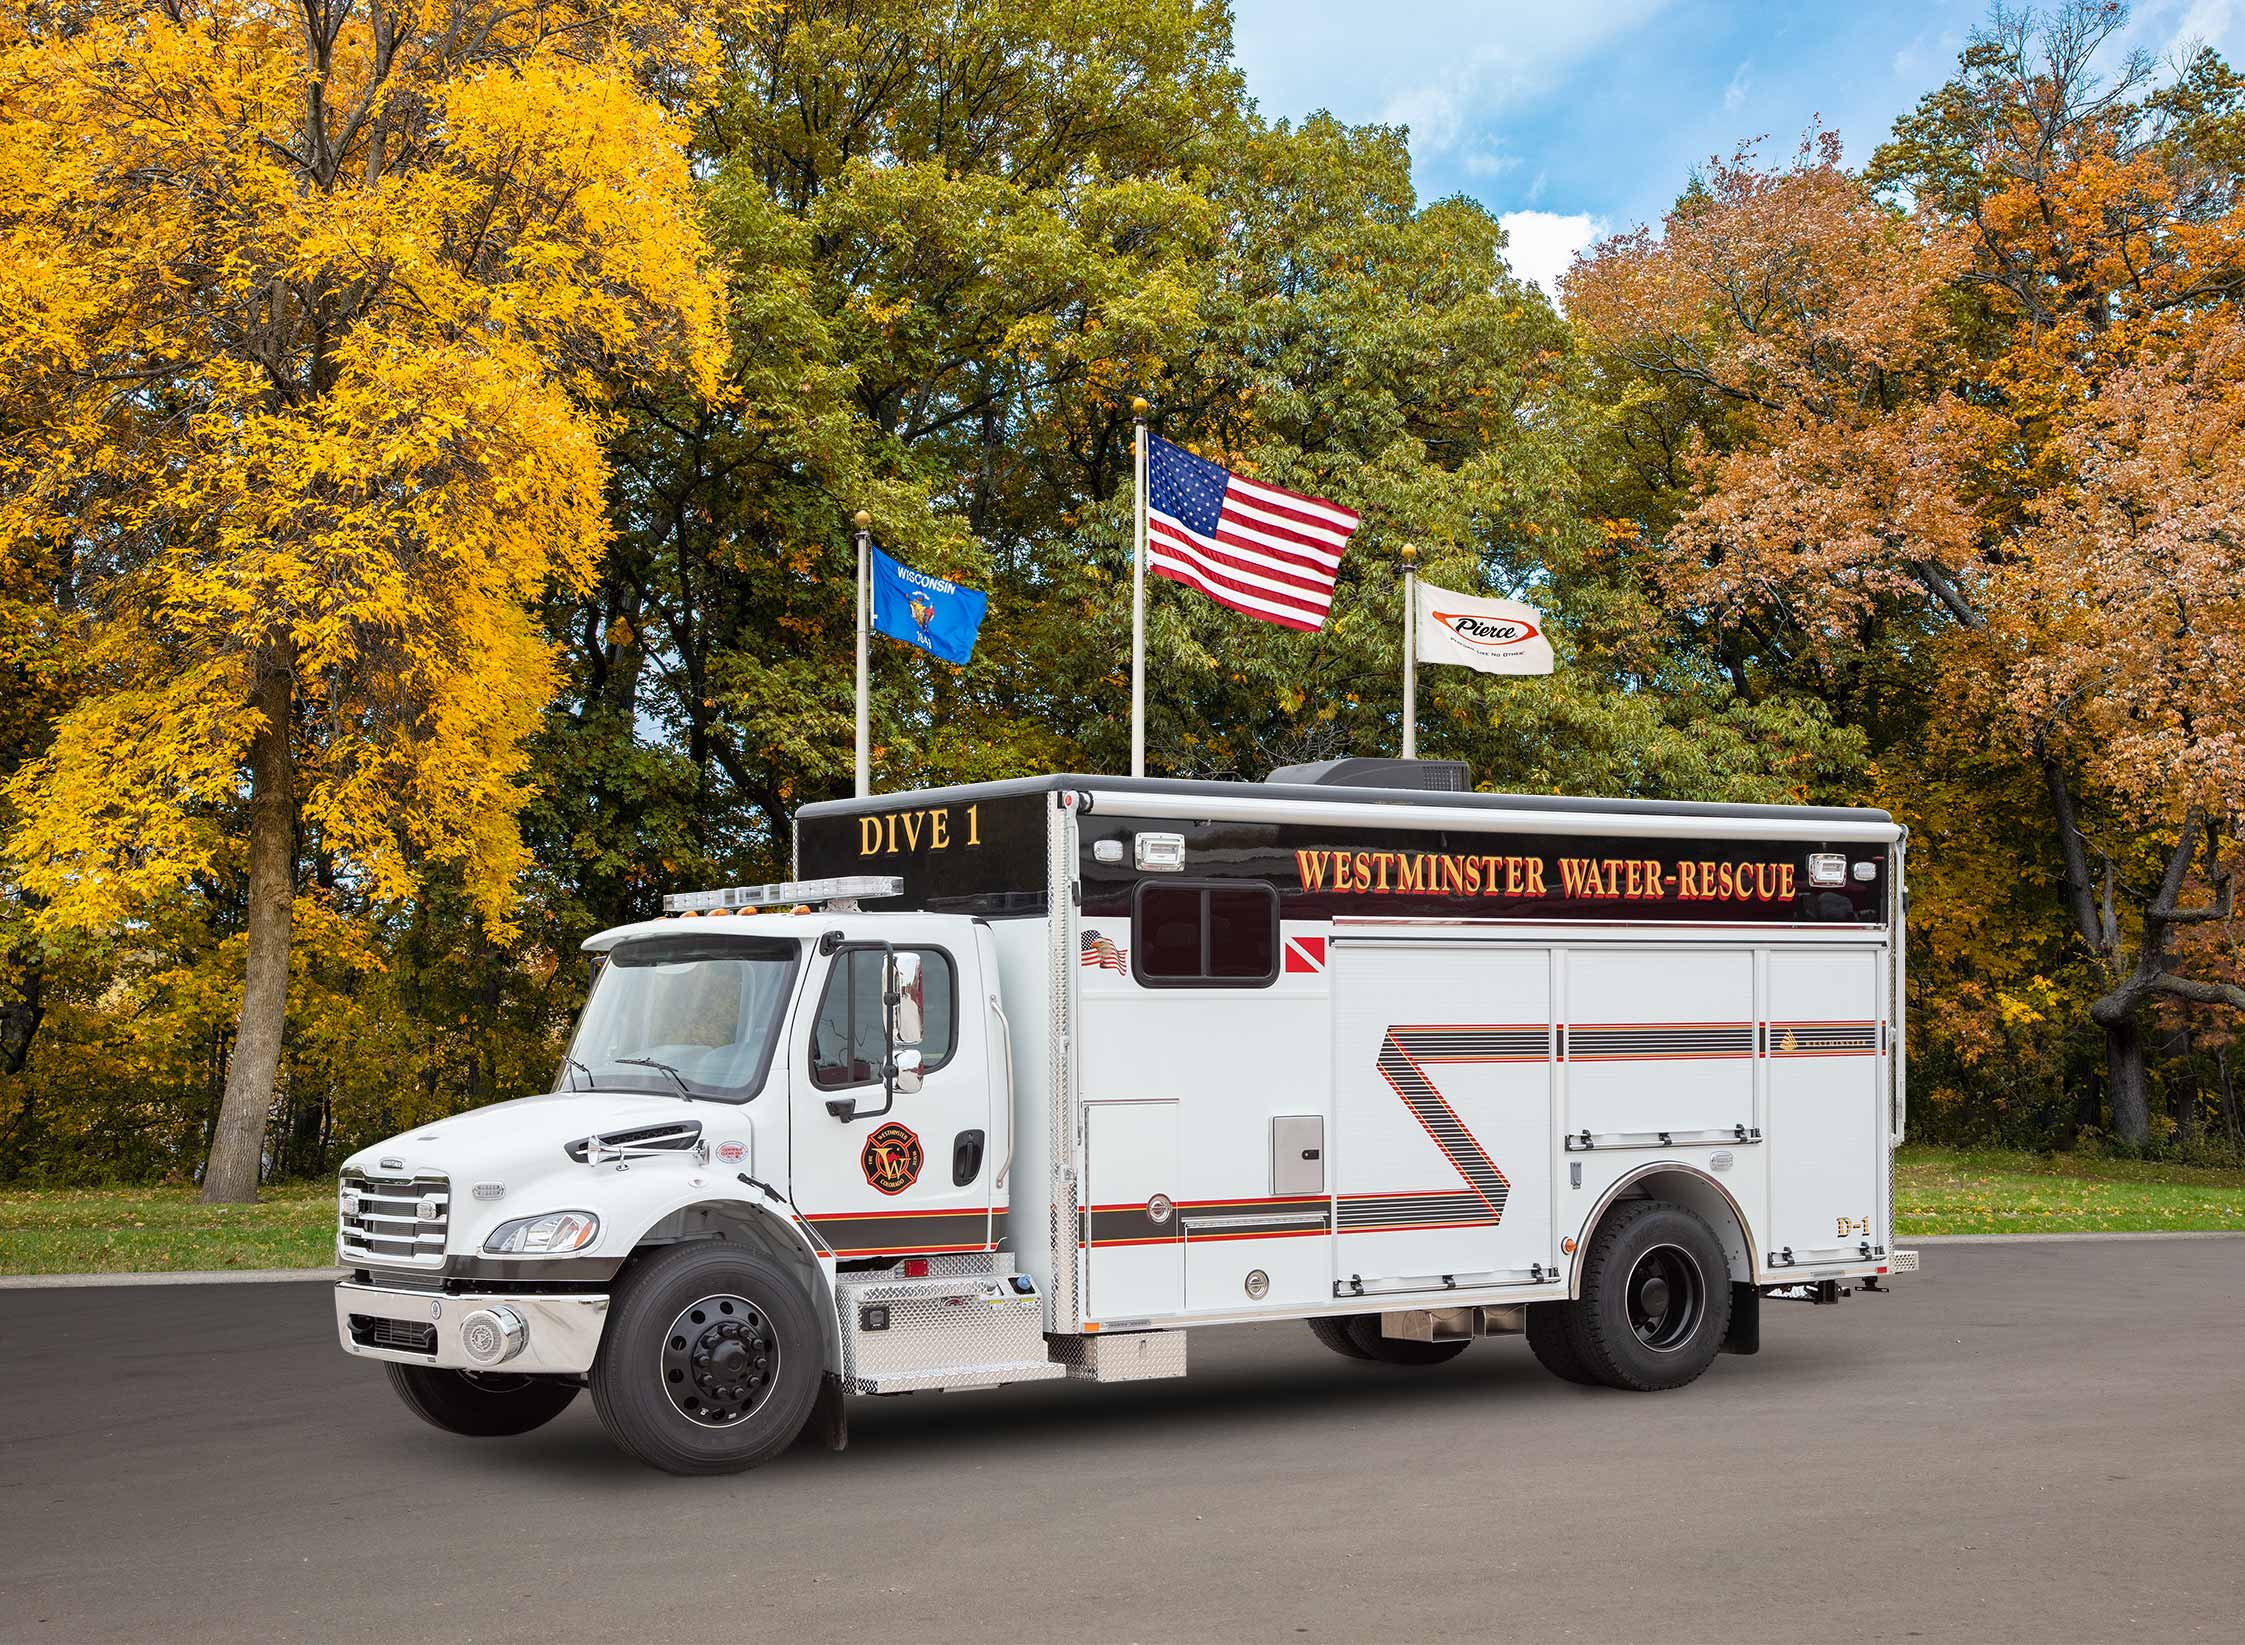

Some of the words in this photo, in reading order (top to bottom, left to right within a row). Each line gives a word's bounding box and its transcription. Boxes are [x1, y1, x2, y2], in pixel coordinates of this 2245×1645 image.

[897, 566, 956, 595] WISCONSIN
[1455, 618, 1516, 639] Pierce
[859, 808, 950, 855] DIVE
[967, 804, 981, 846] 1
[1295, 850, 1547, 897] WESTMINSTER
[1558, 858, 1796, 902] WATER-RESCUE
[1836, 1215, 1870, 1238] D-1
